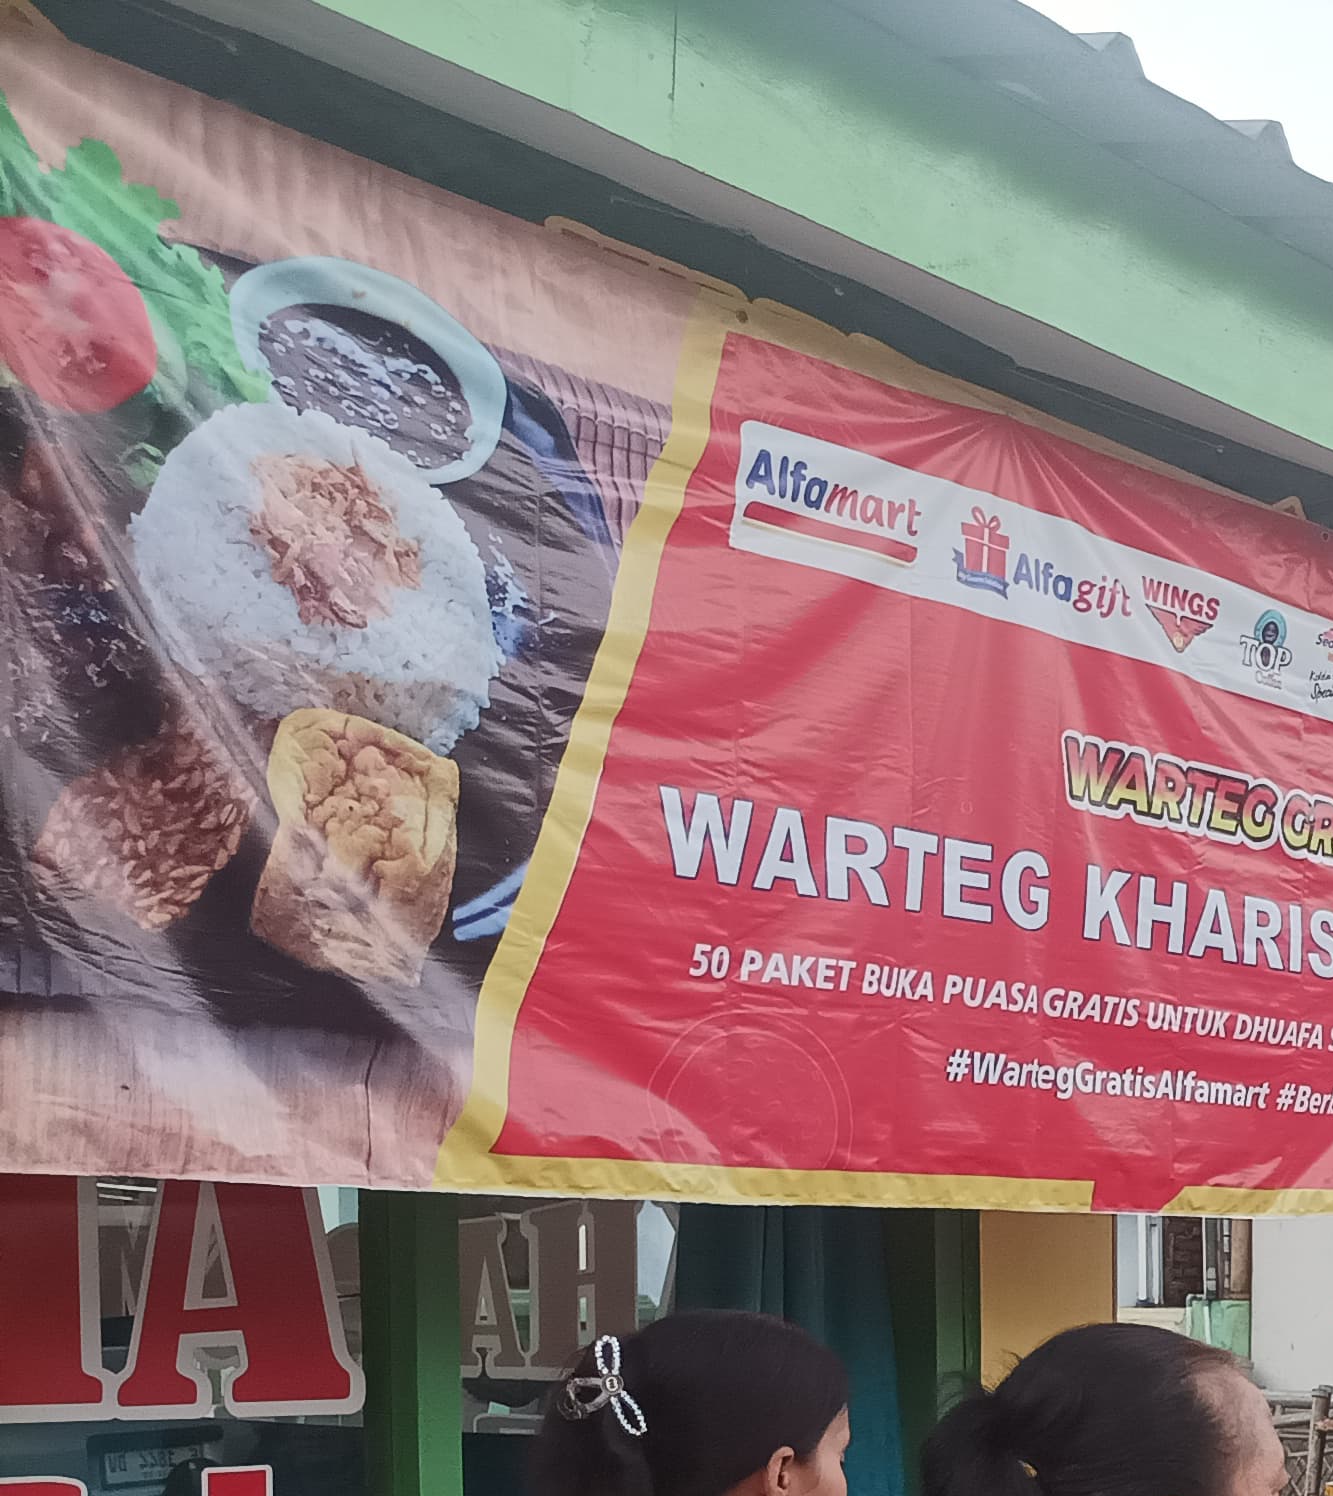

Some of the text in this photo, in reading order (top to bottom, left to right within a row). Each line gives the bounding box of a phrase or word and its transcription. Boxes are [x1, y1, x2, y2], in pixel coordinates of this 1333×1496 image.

[745, 449, 921, 537] Alfamart
[1013, 553, 1132, 618] Alfagift
[1142, 575, 1221, 621] WINGS
[1240, 634, 1293, 673] TOP
[1063, 736, 1277, 841] WARTEG
[659, 785, 1052, 931] WARTEG
[689, 943, 730, 978] 50
[740, 949, 857, 991] PAKET
[861, 963, 934, 1002] BUKA
[943, 974, 1038, 1014] PUASA
[1042, 987, 1141, 1027] GRATIS
[1146, 1003, 1228, 1039] UNTUK
[1233, 1013, 1324, 1051] DHUAFA
